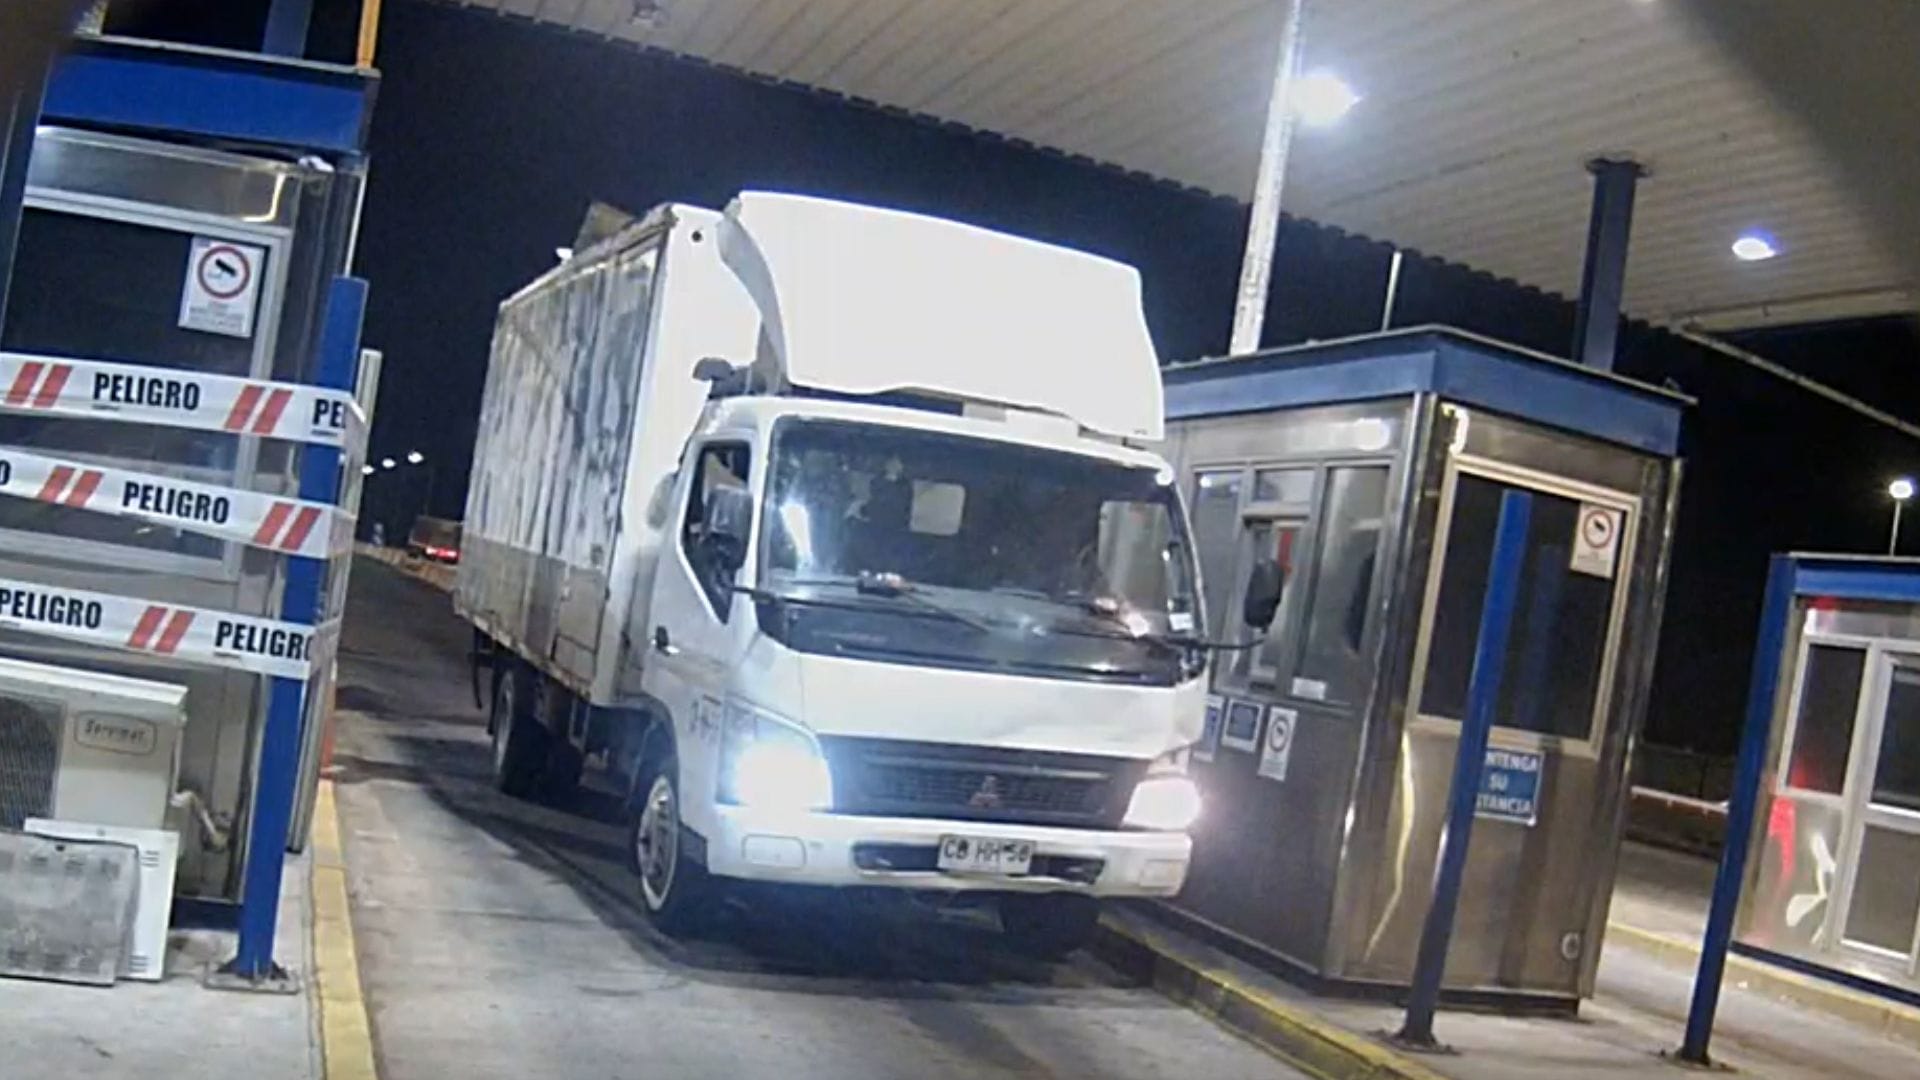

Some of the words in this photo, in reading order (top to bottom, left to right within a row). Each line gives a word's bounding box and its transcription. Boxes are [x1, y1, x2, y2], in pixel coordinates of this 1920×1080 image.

[93, 372, 200, 411] PELIGRO
[312, 398, 346, 429] PE
[122, 481, 230, 524] PELIGRO
[0, 588, 102, 630] PELIGRO
[1486, 752, 1537, 772] NTENGA
[1489, 773, 1509, 791] SU
